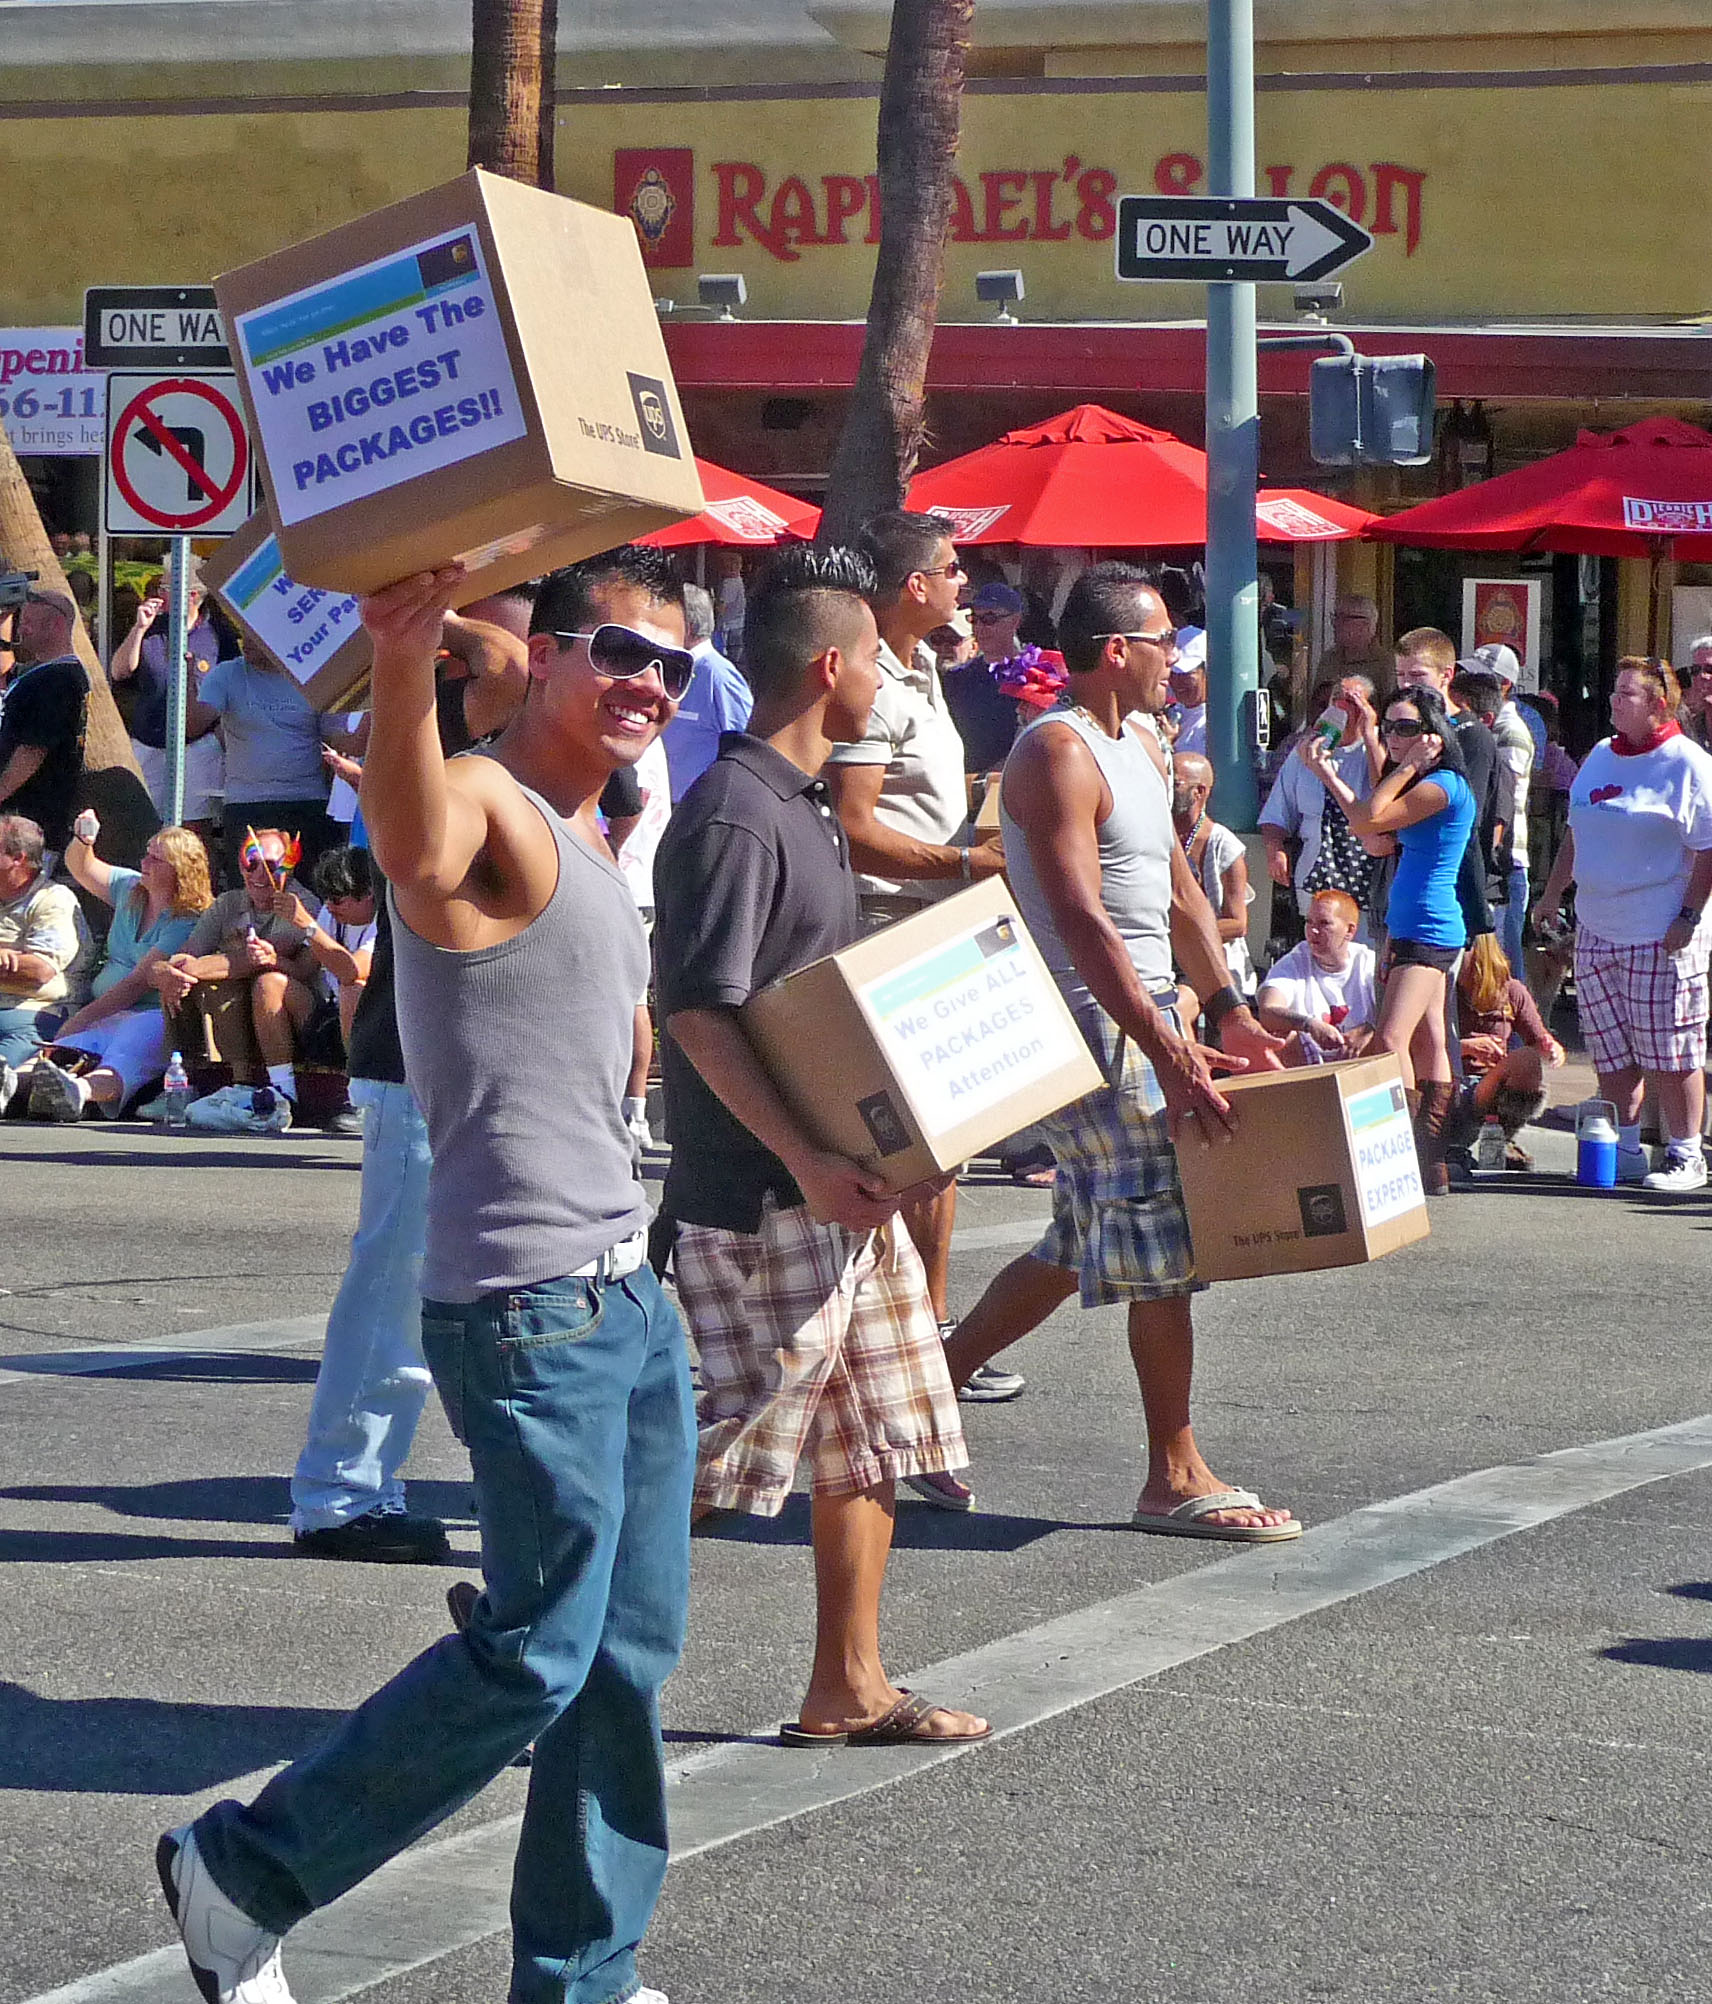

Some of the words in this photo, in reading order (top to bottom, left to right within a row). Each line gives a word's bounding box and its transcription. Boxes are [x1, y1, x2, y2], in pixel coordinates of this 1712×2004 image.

[711, 155, 1118, 262] RAPAEL'S
[1146, 225, 1212, 255] ONE
[1227, 225, 1295, 256] WAY
[109, 313, 166, 343] ONE
[178, 313, 221, 342] WA
[262, 361, 316, 396] We
[323, 324, 410, 373] Have
[415, 295, 486, 334] The
[0, 338, 84, 385] peni
[0, 387, 105, 419] 6-11
[307, 350, 462, 432] BIGGEST
[20, 424, 74, 448] brings
[293, 388, 504, 490] PACKAGES!!
[578, 417, 596, 439] The
[595, 422, 616, 442] UPS
[272, 573, 295, 596] W
[287, 588, 328, 624] SER
[286, 623, 331, 663] Your
[328, 594, 359, 625] Pa
[894, 1015, 929, 1040] We
[934, 988, 980, 1019] Give
[985, 961, 1027, 992] ALL
[920, 999, 1035, 1071] PACKAGES
[949, 1038, 1045, 1100] Attention
[1359, 1130, 1412, 1170] PACKAGE
[1367, 1171, 1419, 1211] EXPERTS
